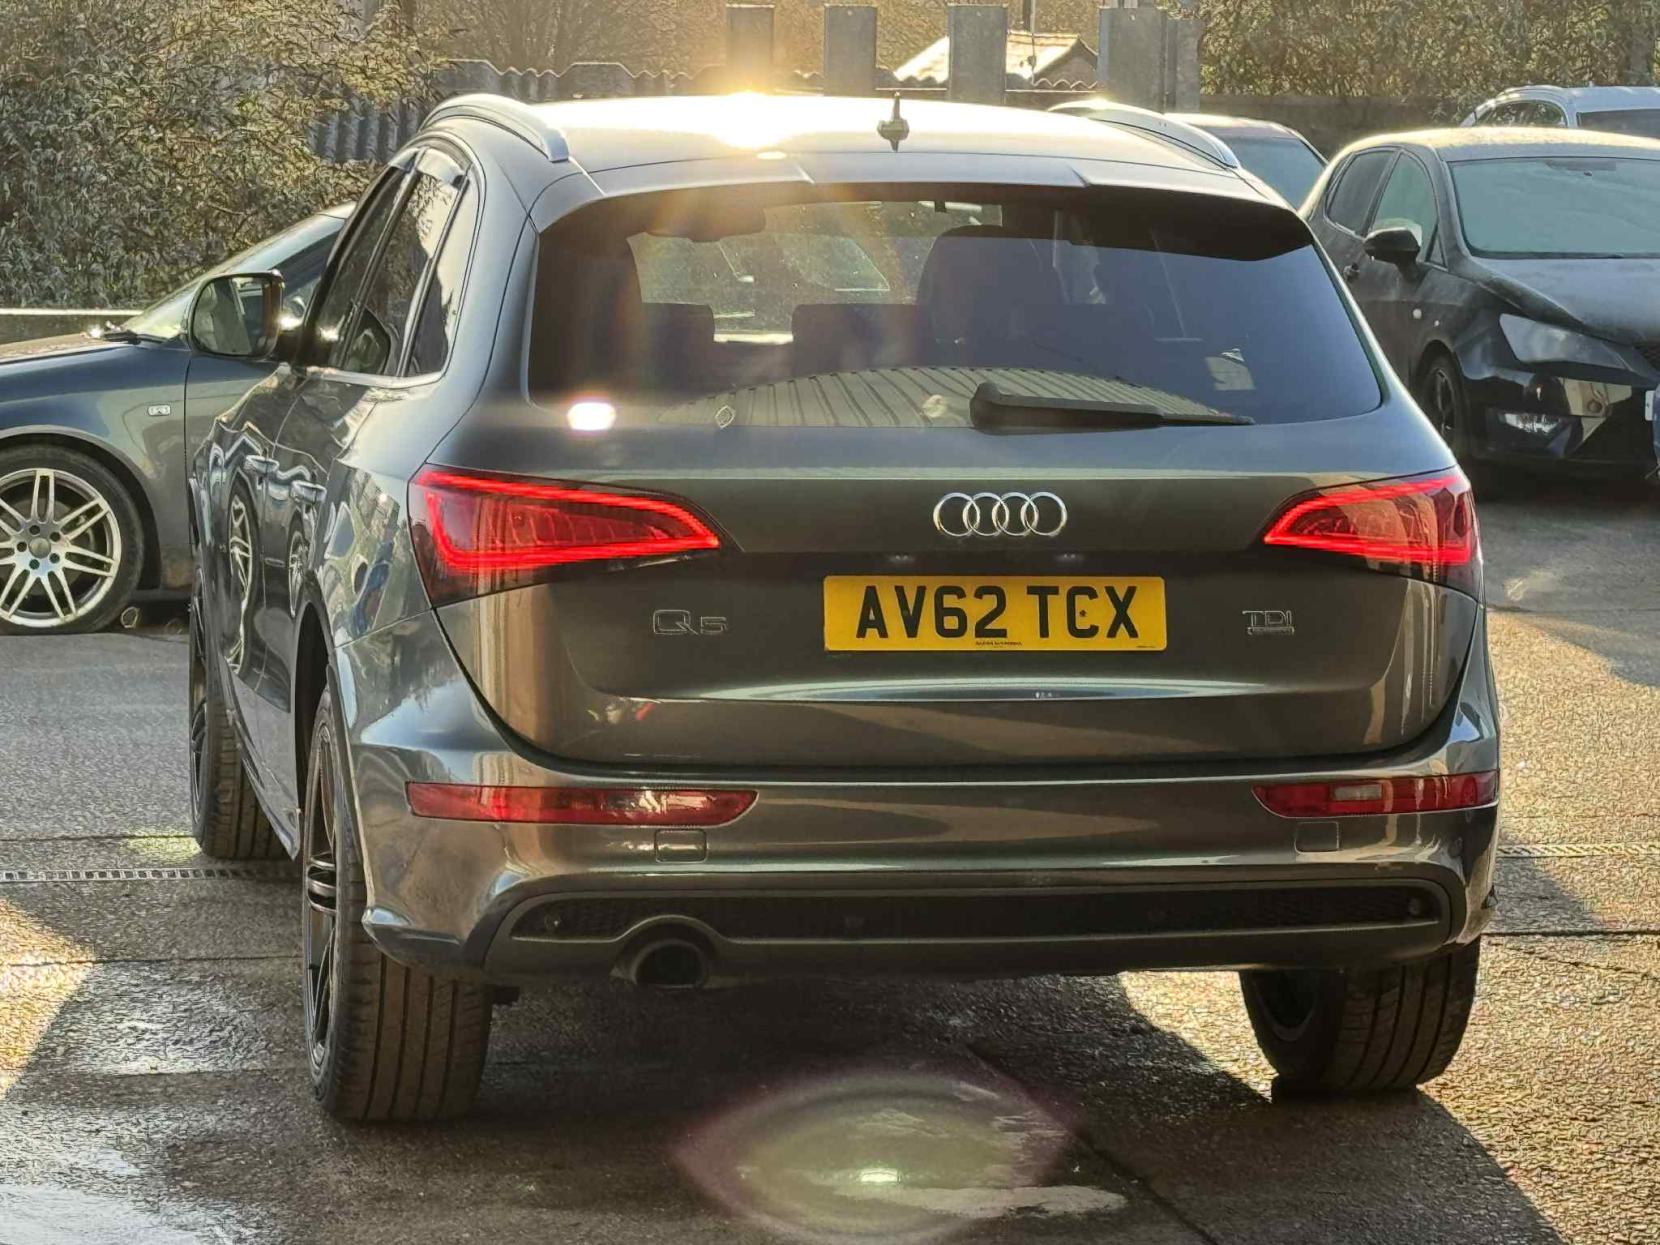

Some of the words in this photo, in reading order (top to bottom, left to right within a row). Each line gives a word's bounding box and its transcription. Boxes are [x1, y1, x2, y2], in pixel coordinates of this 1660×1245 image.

[653, 609, 728, 635] Q5
[856, 585, 1008, 639] AV62
[1026, 585, 1139, 639] TCX
[1242, 610, 1292, 627] TDI
